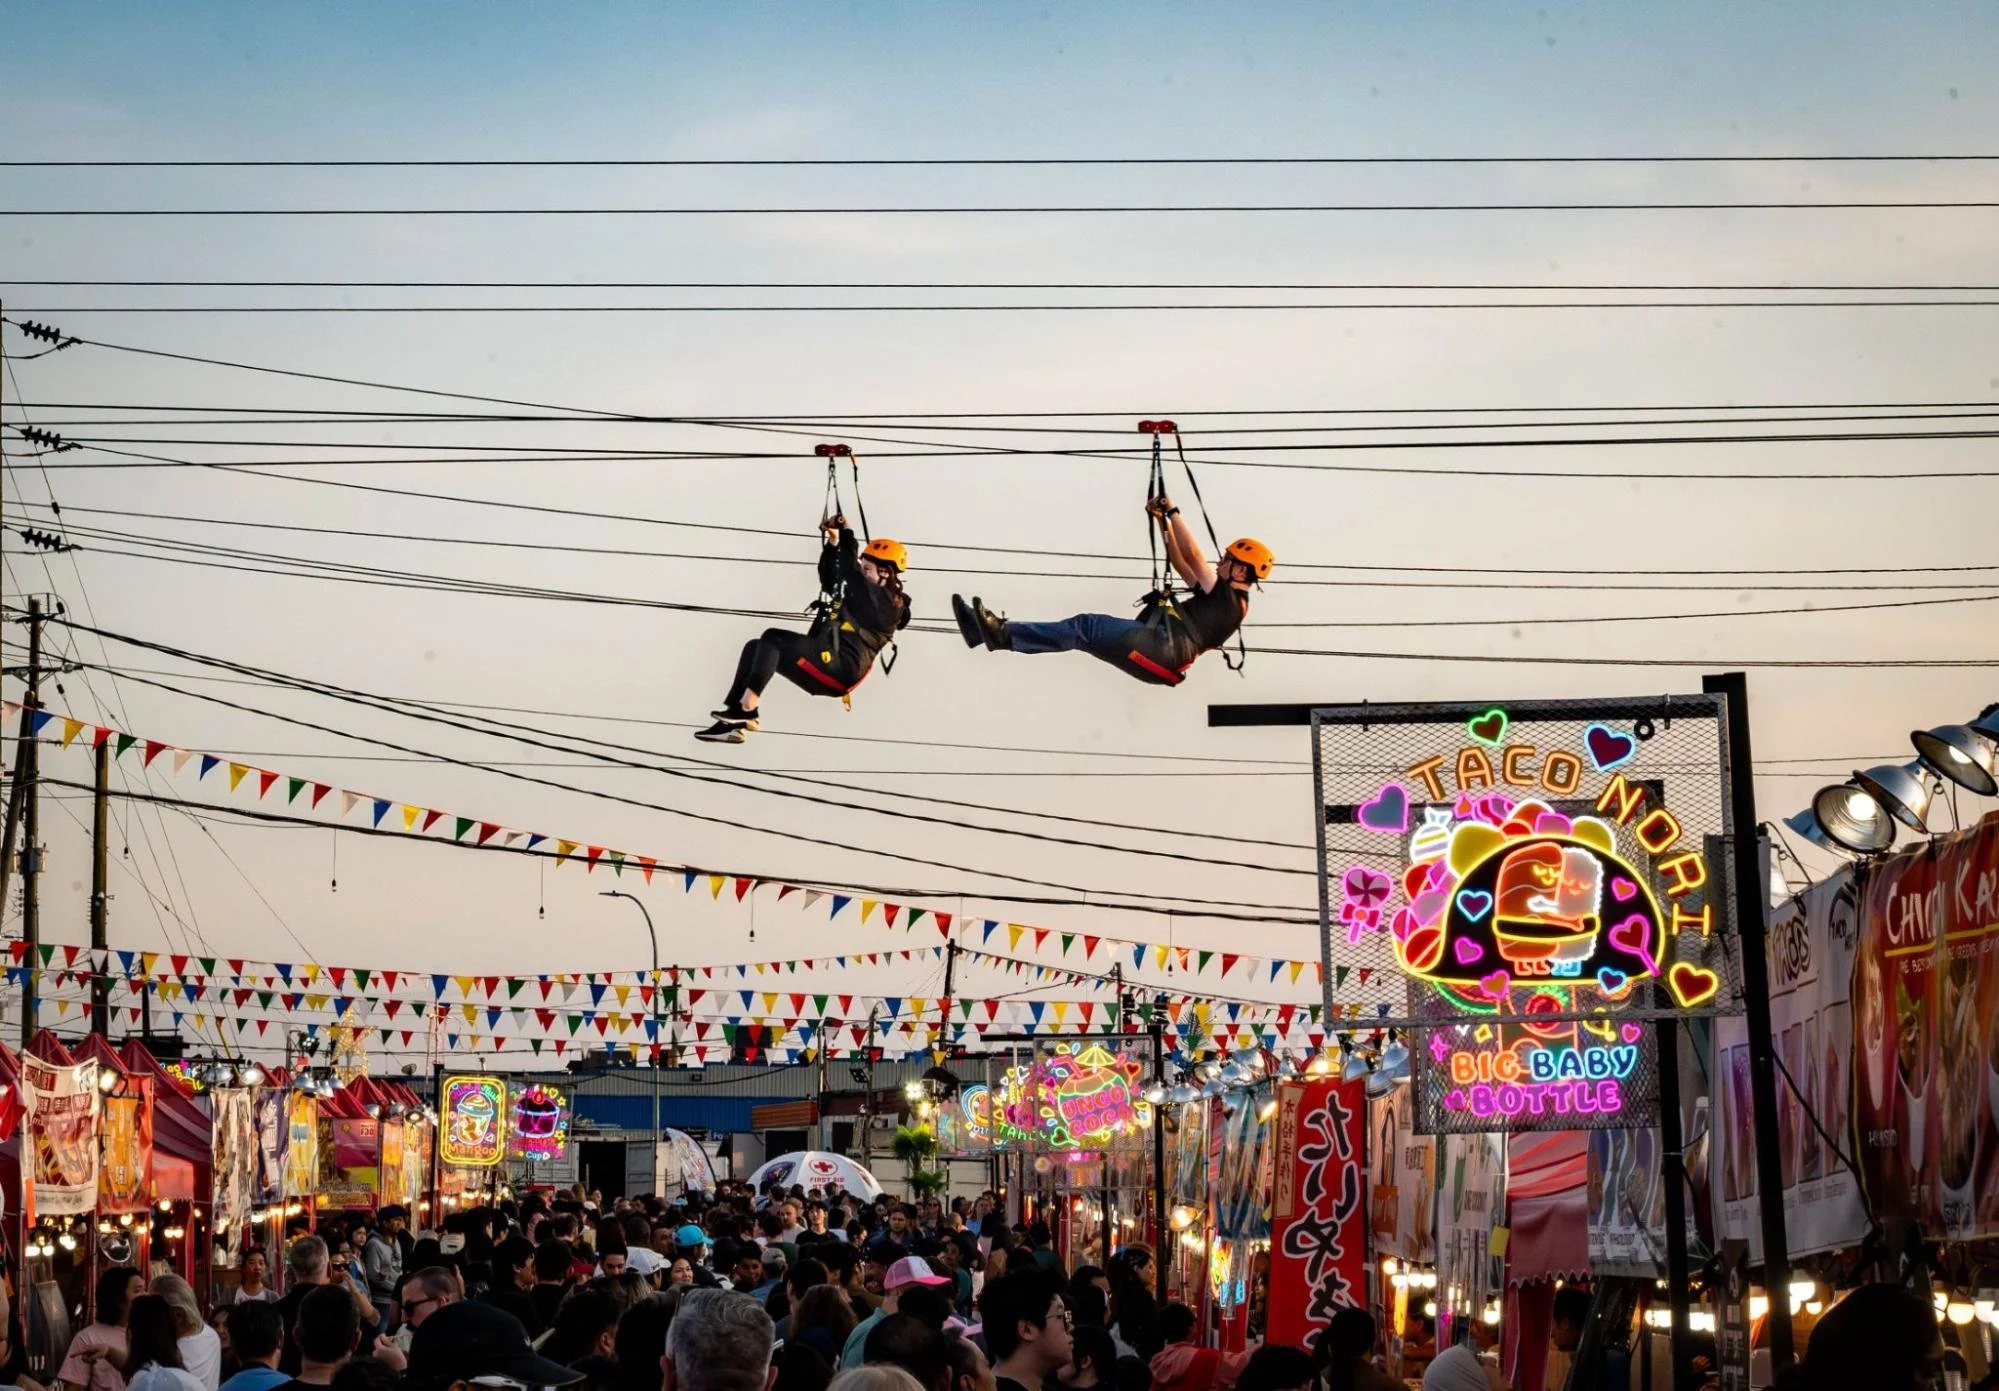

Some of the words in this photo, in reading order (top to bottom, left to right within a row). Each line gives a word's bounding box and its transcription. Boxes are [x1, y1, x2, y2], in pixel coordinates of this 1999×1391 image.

[1407, 744, 1584, 802] TACO
[1596, 773, 1712, 939] NORI
[1451, 1048, 1521, 1084] BIG
[1530, 1043, 1638, 1080] BABY
[1061, 1084, 1126, 1120] UNCO
[1469, 1080, 1624, 1117] BOTTLE
[1067, 1103, 1135, 1140] COCO
[525, 1151, 543, 1160] Cup
